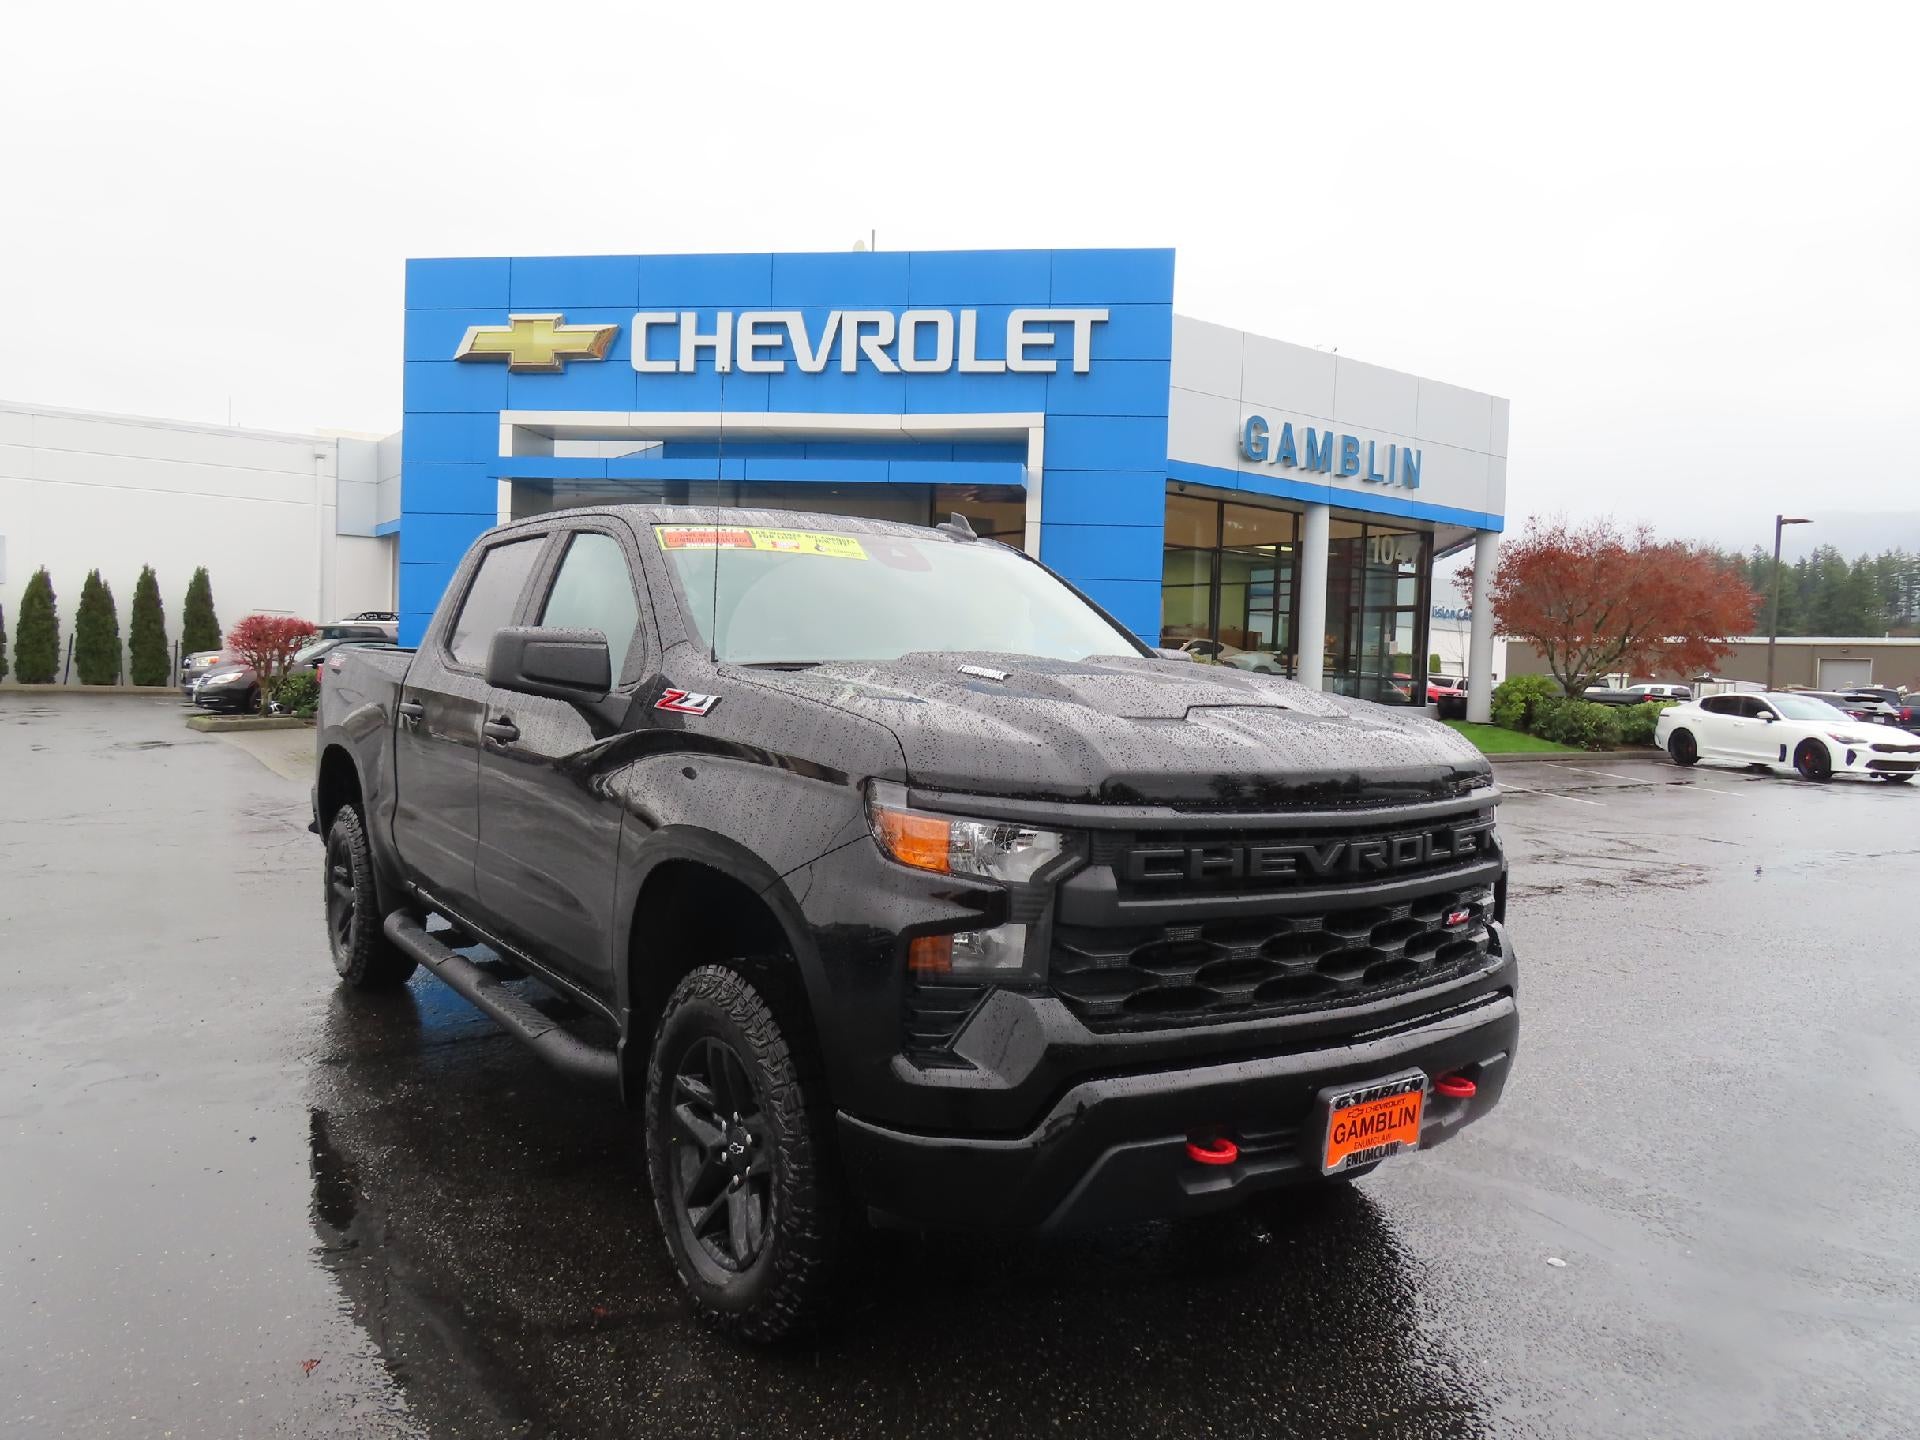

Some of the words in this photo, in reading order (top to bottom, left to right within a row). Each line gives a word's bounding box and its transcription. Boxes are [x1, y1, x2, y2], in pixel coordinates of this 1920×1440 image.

[631, 309, 1109, 374] CHEVROLET
[1242, 415, 1422, 490] GAMBLIN
[654, 688, 723, 716] Z71
[1127, 823, 1496, 880] CHEVROLET
[1364, 1098, 1406, 1114] CHEVROLET
[1333, 1104, 1417, 1145] GAMBLIN
[1354, 1133, 1392, 1150] ENUMCLAW
[1345, 1141, 1401, 1169] ENUMCLAW
